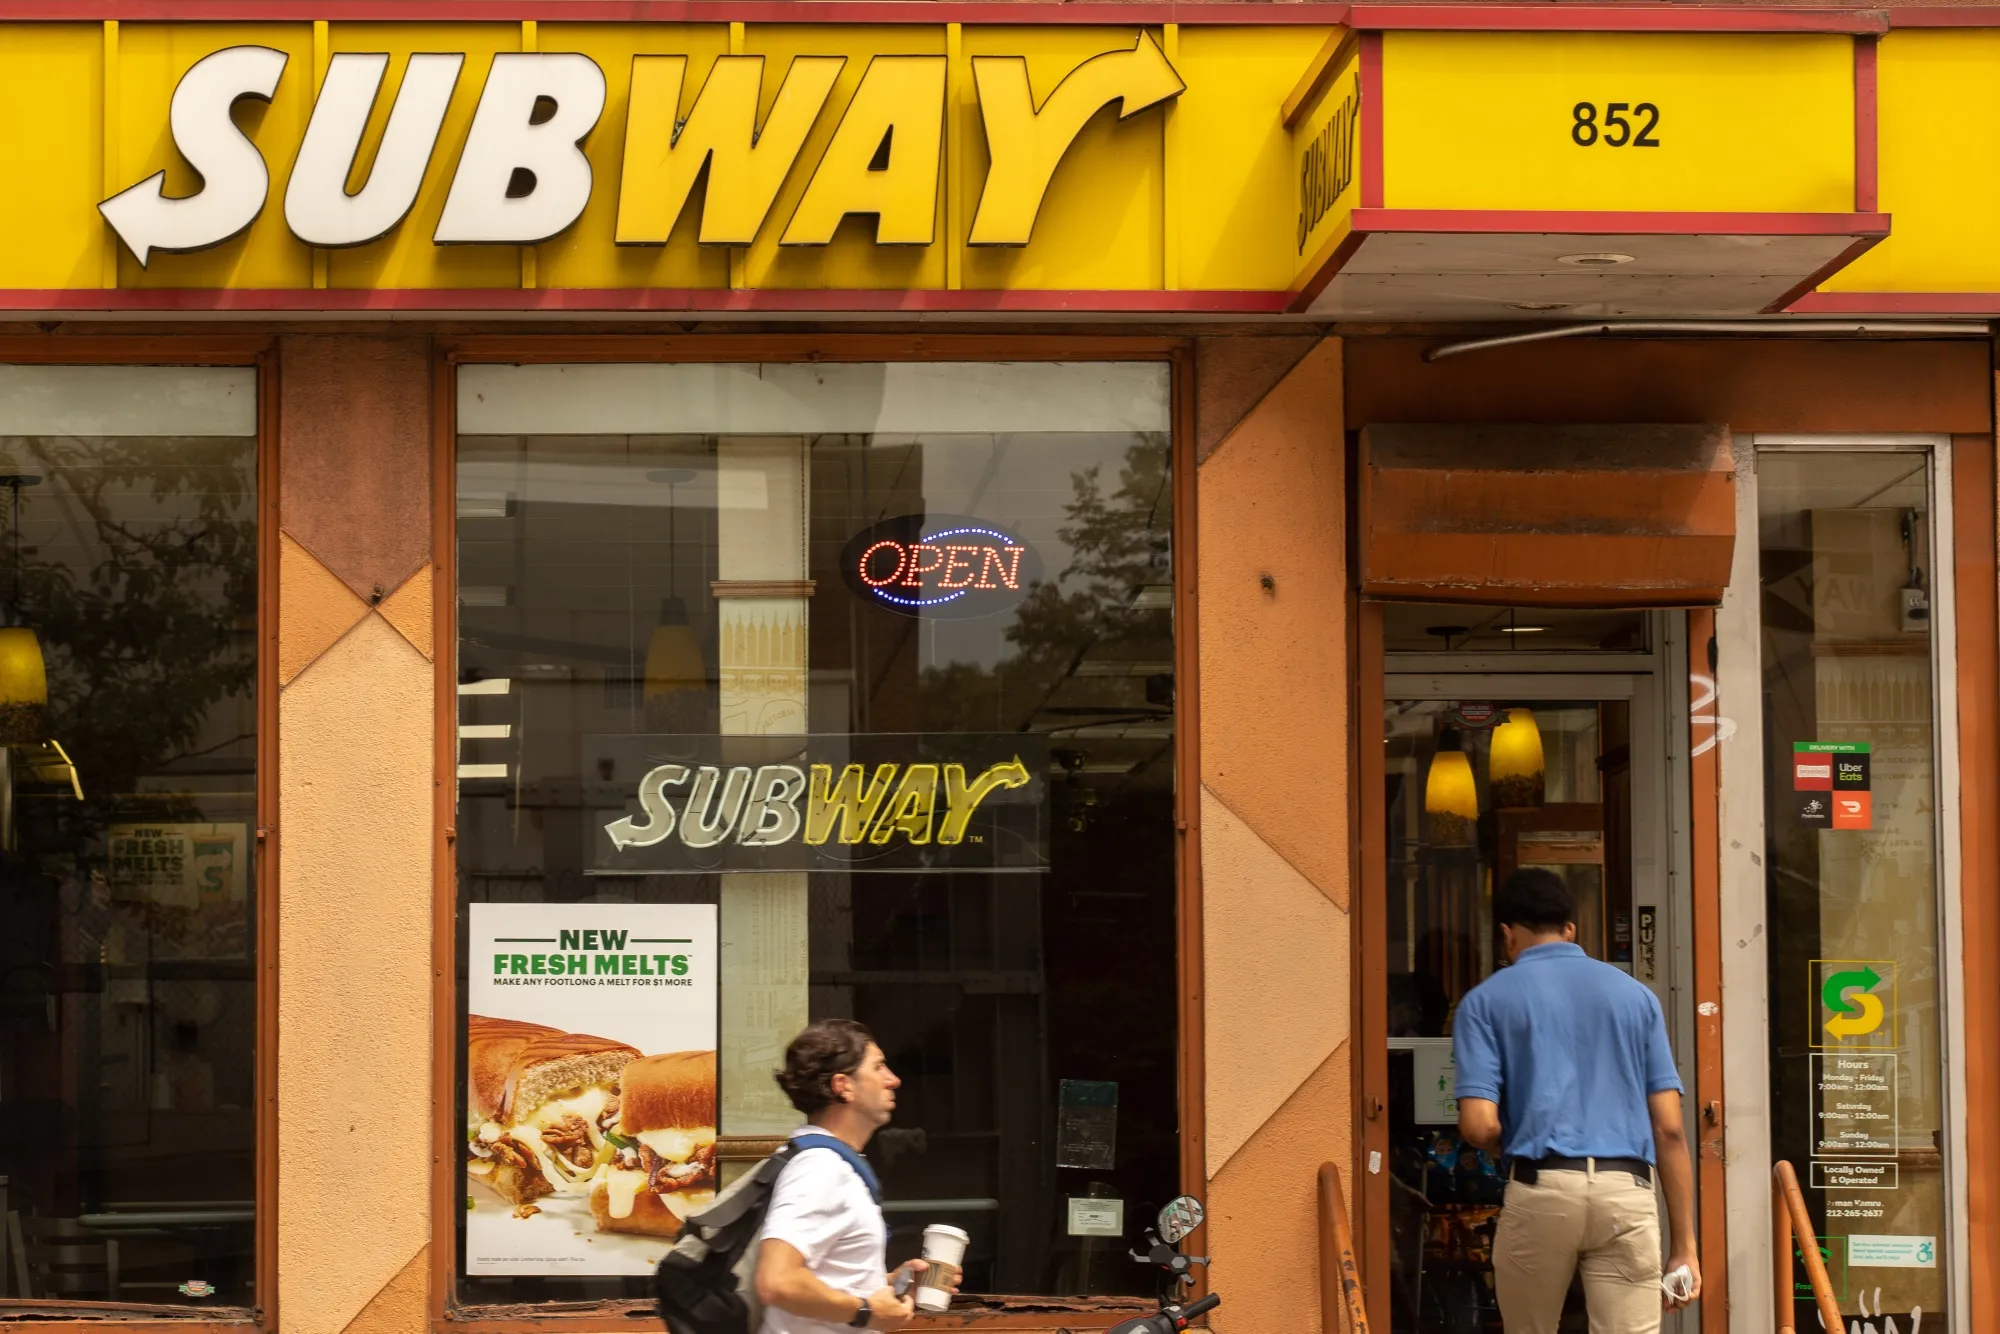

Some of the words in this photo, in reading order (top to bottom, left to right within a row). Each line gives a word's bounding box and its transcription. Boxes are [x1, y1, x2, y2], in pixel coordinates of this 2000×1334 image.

[1571, 101, 1660, 147] 852
[97, 27, 1186, 268] SUBWAY
[1298, 71, 1360, 256] SUBWAY
[859, 540, 1025, 589] OPEN
[1839, 763, 1863, 772] Uber
[1839, 772, 1863, 781] Eats
[604, 754, 1031, 852] SUBWAY
[134, 828, 162, 837] NEW
[113, 839, 184, 855] FRESH
[113, 857, 184, 871] MELTS
[560, 929, 628, 950] NEW
[494, 954, 588, 975] FRESH
[594, 954, 689, 975] MELTS
[494, 977, 521, 986] MAKE
[523, 978, 542, 986] ANY
[544, 978, 596, 986] FOOTLONG
[598, 978, 605, 986] A
[606, 978, 630, 986] MELT
[632, 978, 651, 986] FOR
[653, 978, 663, 987] $1
[665, 978, 692, 987] MORE
[1837, 1060, 1869, 1069] Hours
[1823, 1074, 1854, 1082] Monday
[1860, 1074, 1884, 1082] Friday
[1836, 1103, 1871, 1111] Saturday
[1840, 1132, 1869, 1140] Sunday
[1824, 1165, 1854, 1175] Locally
[1855, 1166, 1884, 1174] Owned
[1830, 1176, 1838, 1184] &
[1838, 1176, 1878, 1185] Operated
[1826, 1209, 1884, 1217] 212-265-2637
